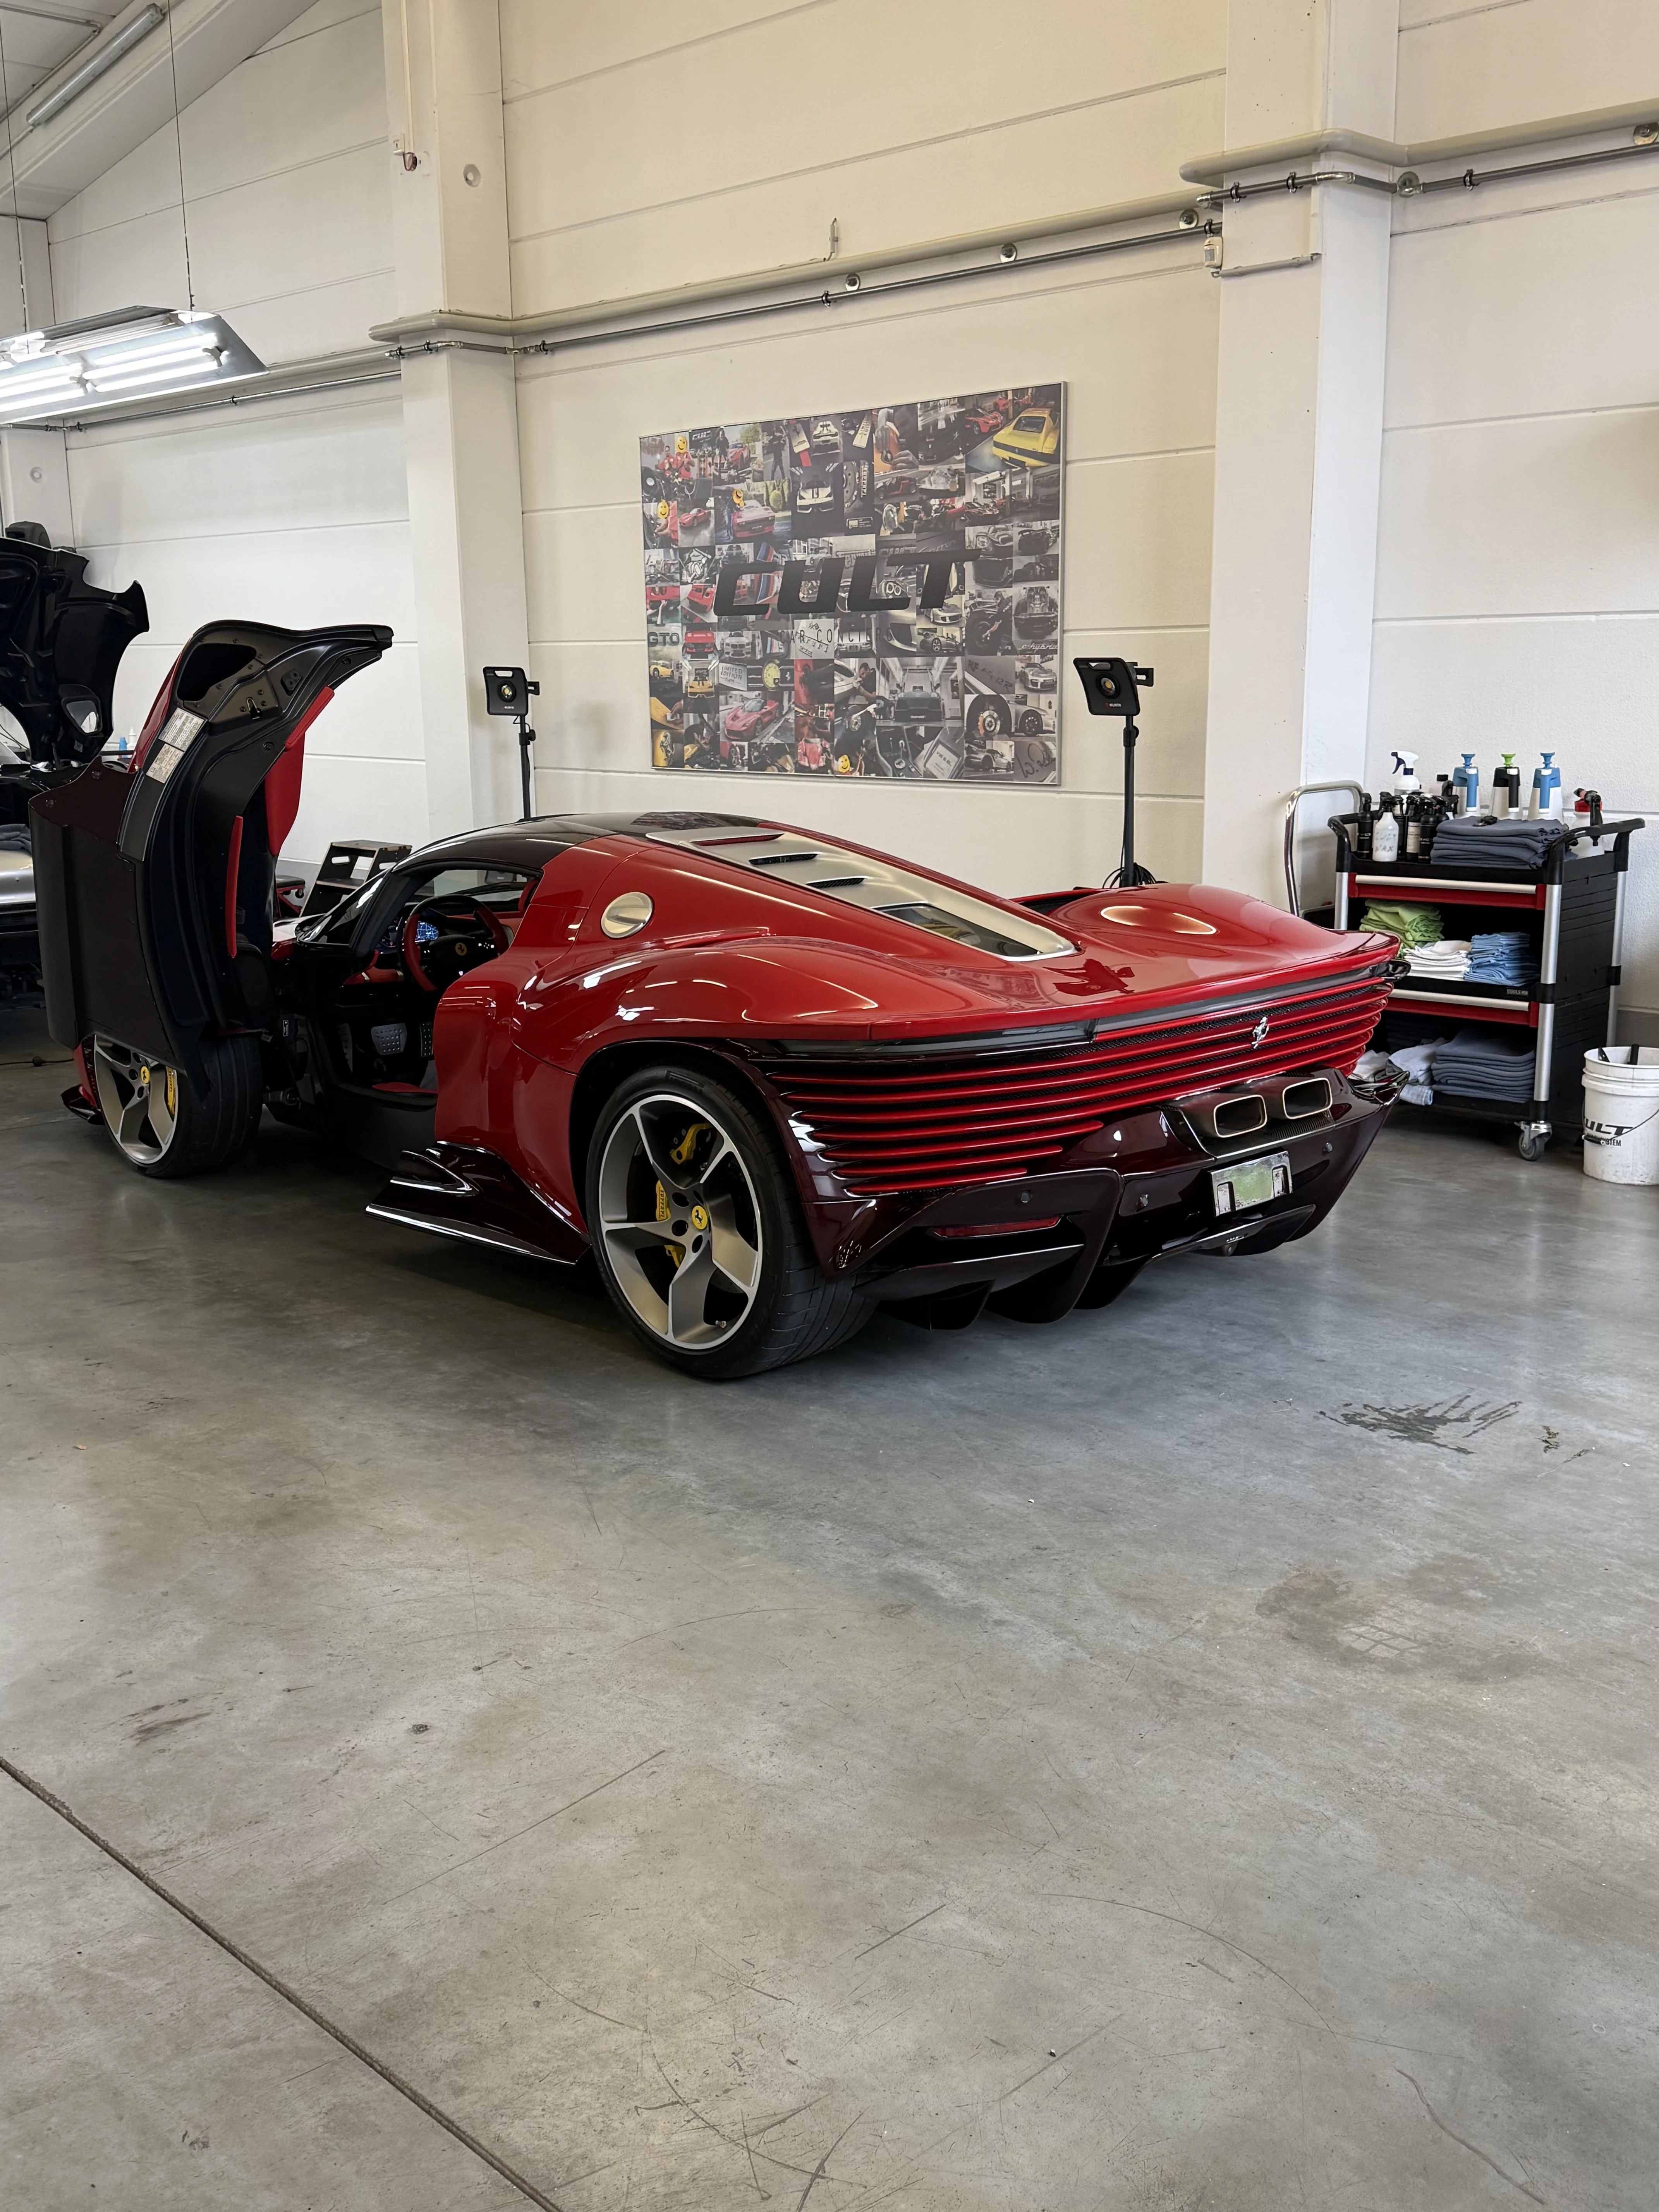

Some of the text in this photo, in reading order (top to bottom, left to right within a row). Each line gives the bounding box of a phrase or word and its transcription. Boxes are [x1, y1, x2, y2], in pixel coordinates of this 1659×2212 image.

[713, 549, 981, 617] CULT
[647, 631, 680, 647] GTO
[780, 629, 805, 644] CAR
[721, 665, 742, 674] LIMITED
[1585, 1117, 1633, 1136] ULT
